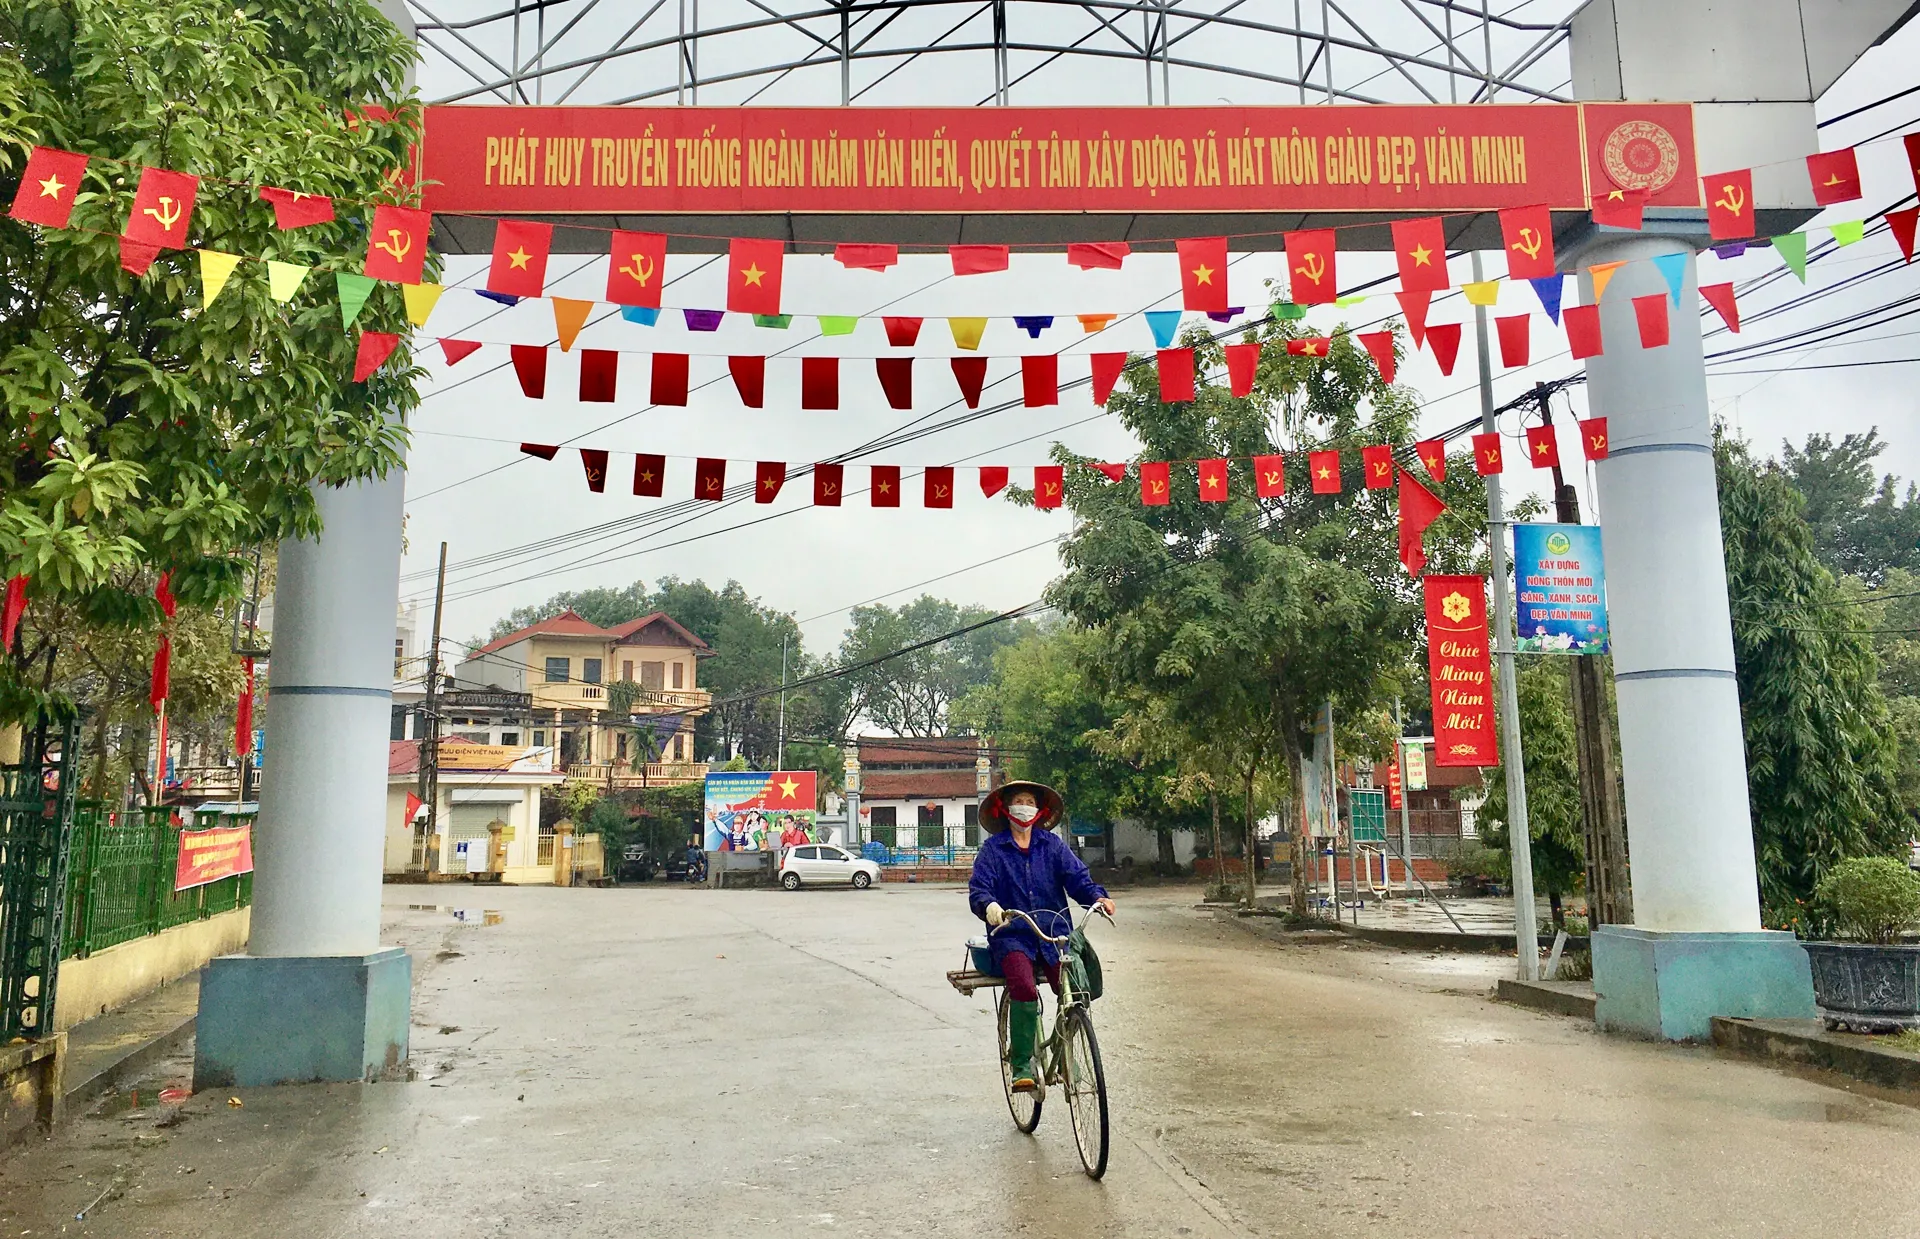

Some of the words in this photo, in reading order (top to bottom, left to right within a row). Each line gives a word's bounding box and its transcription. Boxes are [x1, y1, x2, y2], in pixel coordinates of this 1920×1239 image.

[485, 128, 541, 187] PHÁT
[545, 138, 587, 188] HUY
[591, 123, 669, 188] TRUYỀN
[675, 125, 743, 189] THỐNG
[749, 130, 806, 189] NGÀN
[811, 130, 859, 188] NĂM
[864, 130, 905, 188] VĂN
[911, 127, 965, 195] HIẾN,
[970, 128, 1033, 195] QUYẾT
[1038, 131, 1082, 189] TÂM
[1087, 131, 1127, 189] XÂY
[1132, 131, 1188, 198] DỰNG
[1193, 130, 1222, 188] XÃ
[1227, 128, 1265, 187] HÁT
[1270, 127, 1320, 187] MÔN
[1325, 128, 1372, 186] GIÀU
[1377, 136, 1422, 195] ĐẸP,
[1424, 127, 1468, 186] VĂN
[1472, 136, 1529, 185] MINH
[1538, 559, 1555, 570] XÂY
[1527, 575, 1551, 586] NÔNG
[1552, 576, 1575, 586] THÔN
[1521, 591, 1546, 604] SÁNG,
[1548, 593, 1574, 604] XANH,
[1575, 594, 1601, 605] SẠCH,
[1569, 611, 1592, 620] MINH
[1439, 640, 1480, 658] Chúc
[1435, 664, 1485, 685] Mừng
[1439, 688, 1484, 706] Năm
[1441, 712, 1483, 730] Mới!
